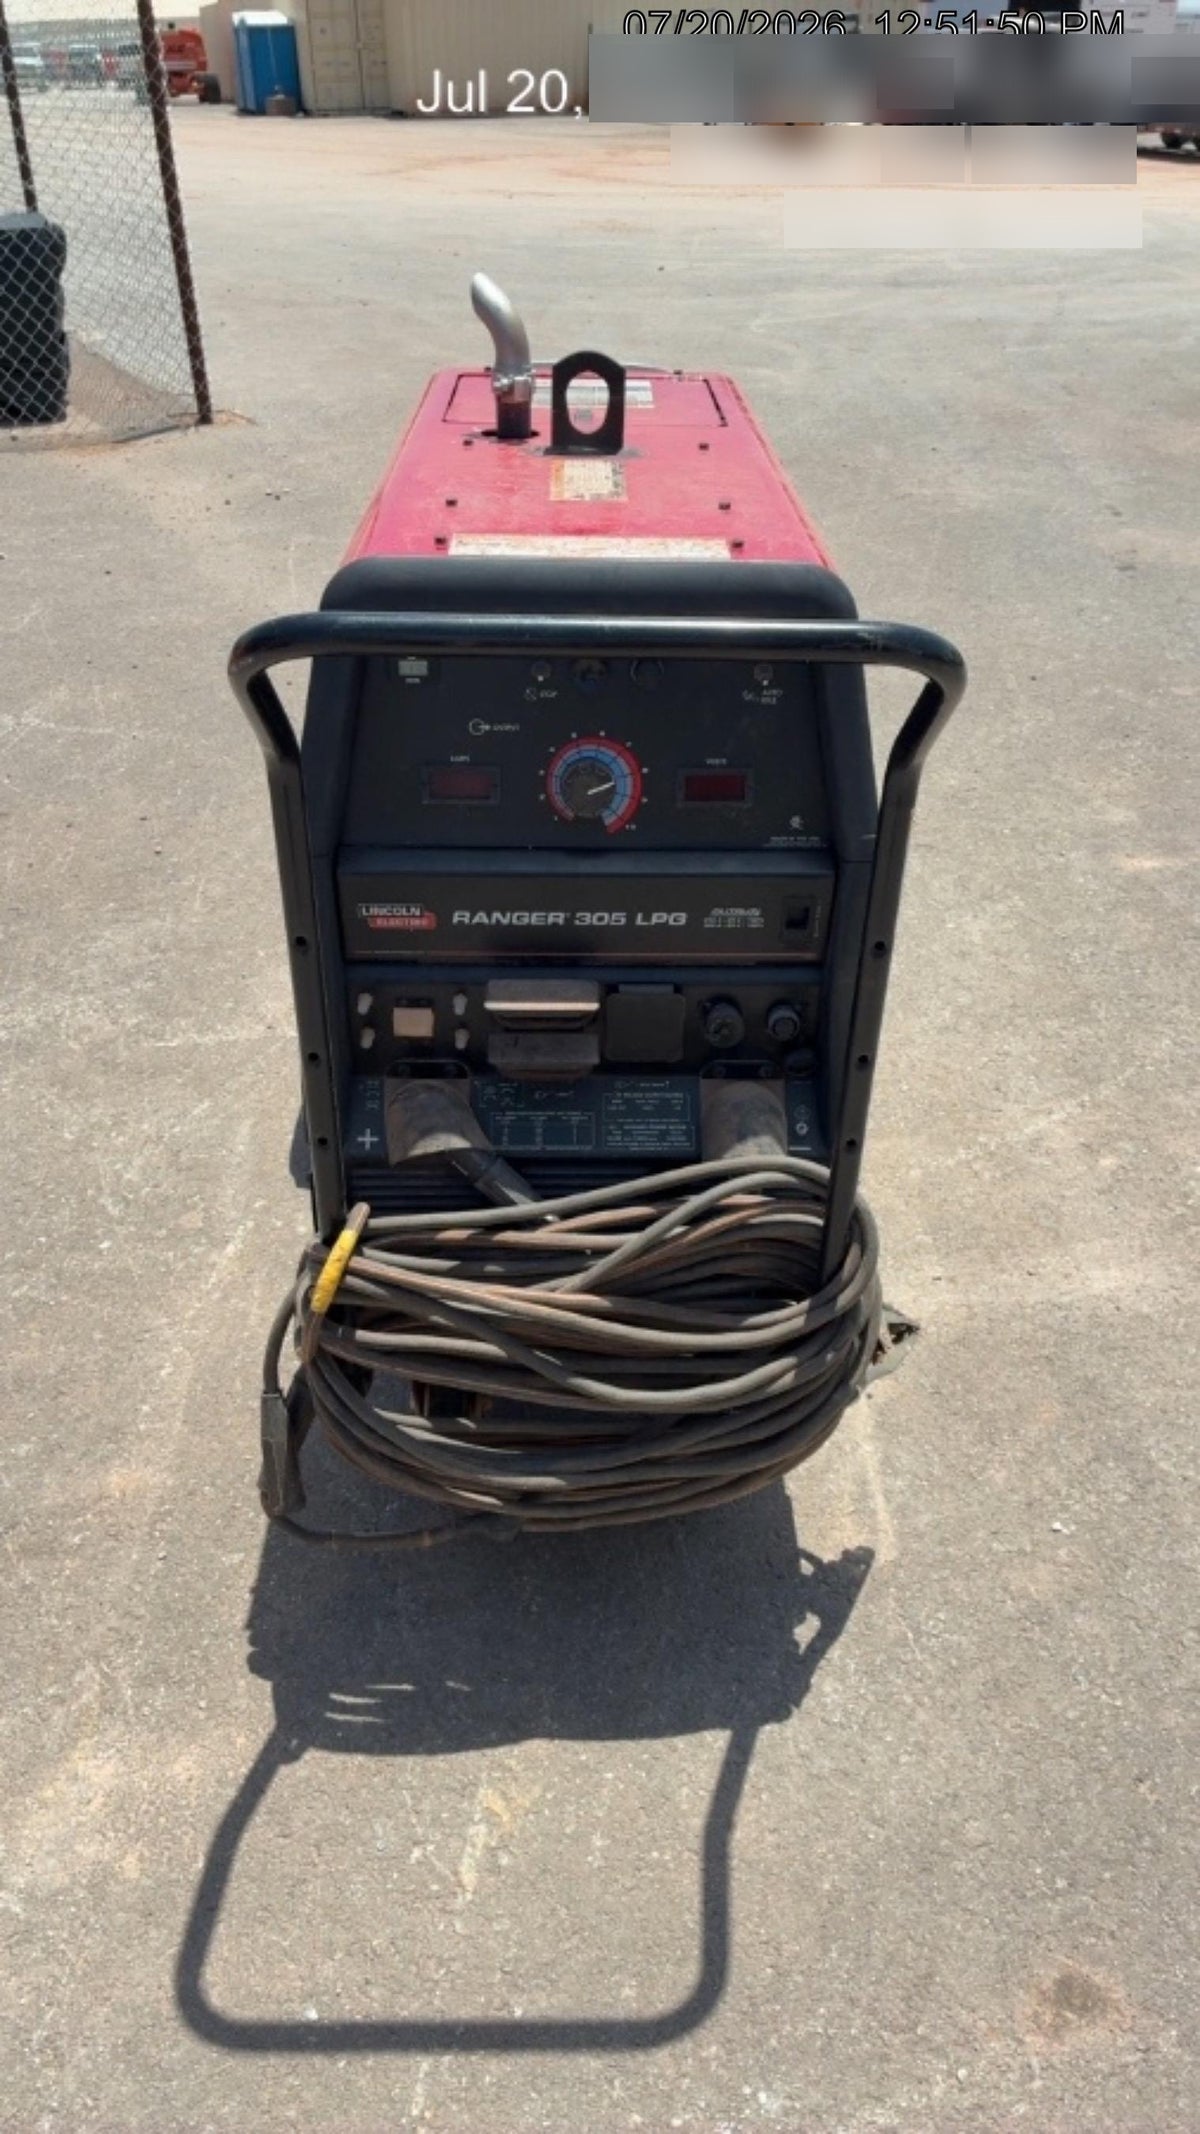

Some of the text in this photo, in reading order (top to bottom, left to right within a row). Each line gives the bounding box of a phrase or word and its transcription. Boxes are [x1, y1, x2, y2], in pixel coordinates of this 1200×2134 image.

[361, 904, 421, 916] LINCOLN
[452, 910, 566, 926] RANGER
[573, 911, 627, 926] 305
[635, 911, 689, 926] LPG
